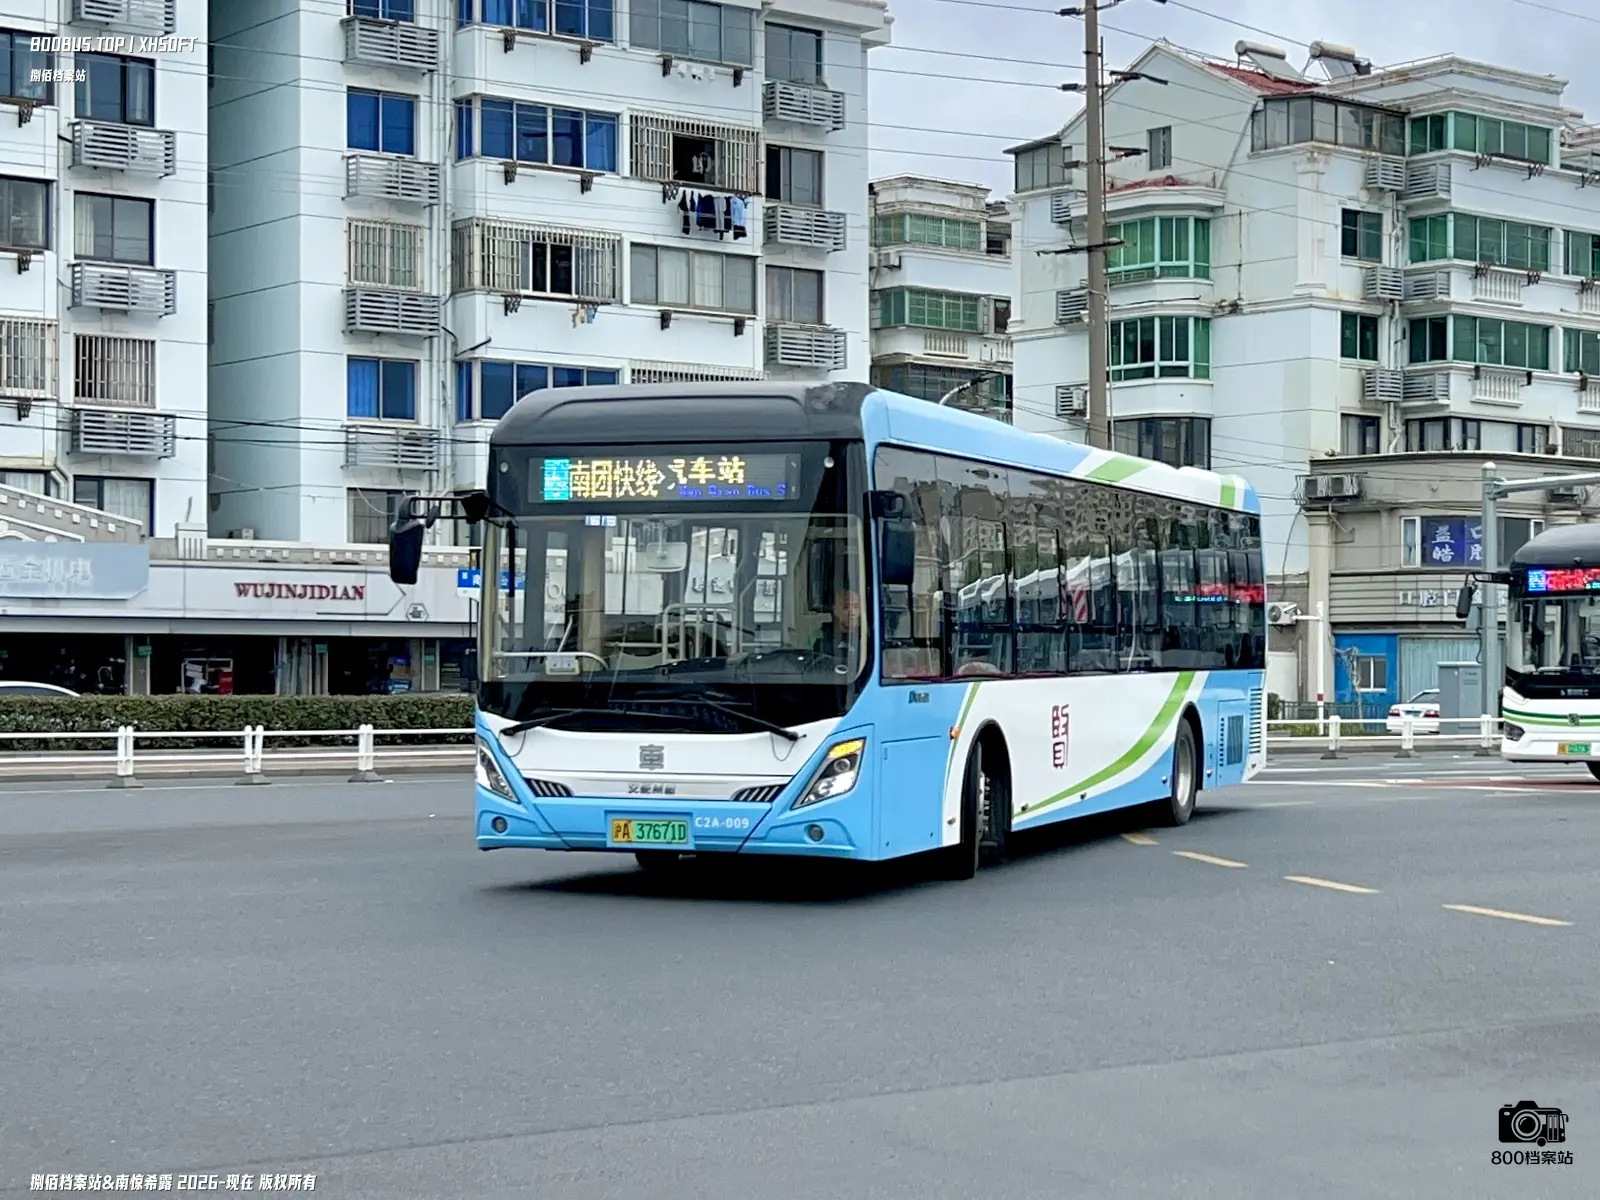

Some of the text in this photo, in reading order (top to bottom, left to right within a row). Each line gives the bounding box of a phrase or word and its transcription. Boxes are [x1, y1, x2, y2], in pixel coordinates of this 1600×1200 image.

[747, 484, 770, 497] Bus
[234, 582, 365, 601] WUJINJIDIAN
[695, 817, 750, 829] C2A-009
[636, 823, 686, 841] 37671D
